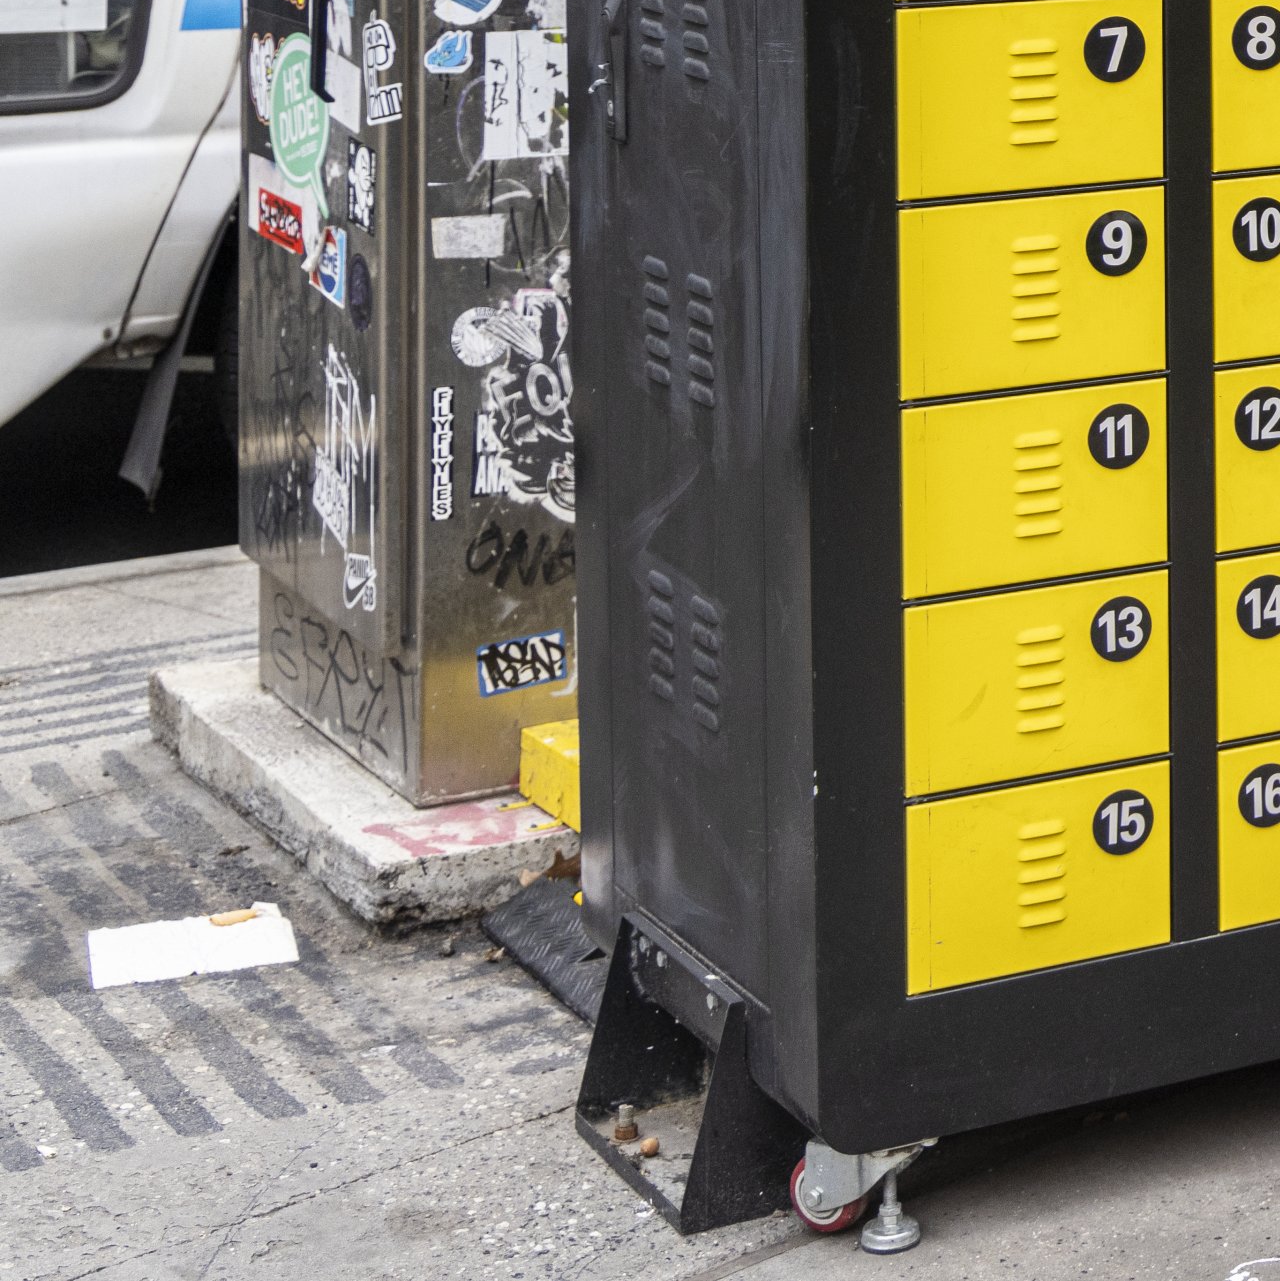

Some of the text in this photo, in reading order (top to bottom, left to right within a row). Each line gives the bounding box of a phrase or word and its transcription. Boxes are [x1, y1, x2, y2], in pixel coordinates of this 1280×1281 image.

[1100, 26, 1127, 72] 7
[1247, 16, 1276, 60] 8
[283, 59, 309, 107] HEY
[279, 96, 319, 148] DUDE!
[1102, 220, 1132, 265] 9
[1100, 414, 1132, 458] 11
[1098, 606, 1143, 652] 13
[1102, 799, 1145, 845] 15
